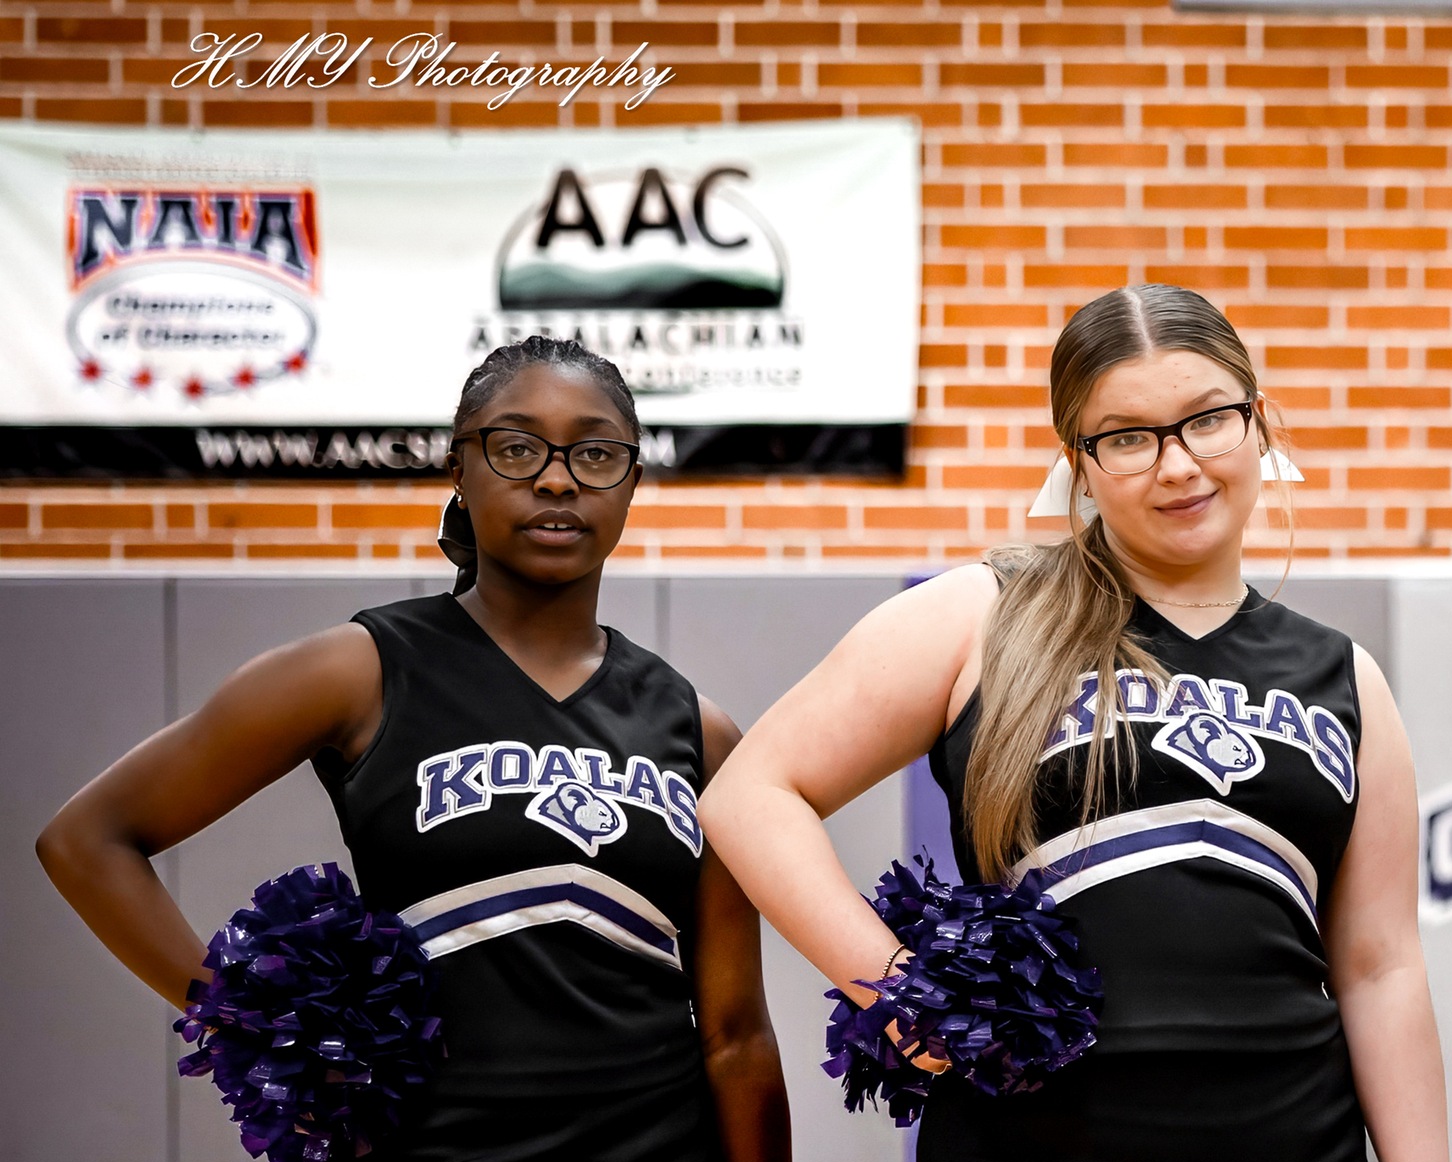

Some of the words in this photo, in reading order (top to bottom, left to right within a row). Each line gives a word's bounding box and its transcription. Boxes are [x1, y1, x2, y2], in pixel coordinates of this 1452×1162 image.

[79, 191, 309, 275] NAIA
[535, 168, 750, 249] AAC
[416, 741, 703, 858] KOALAS
